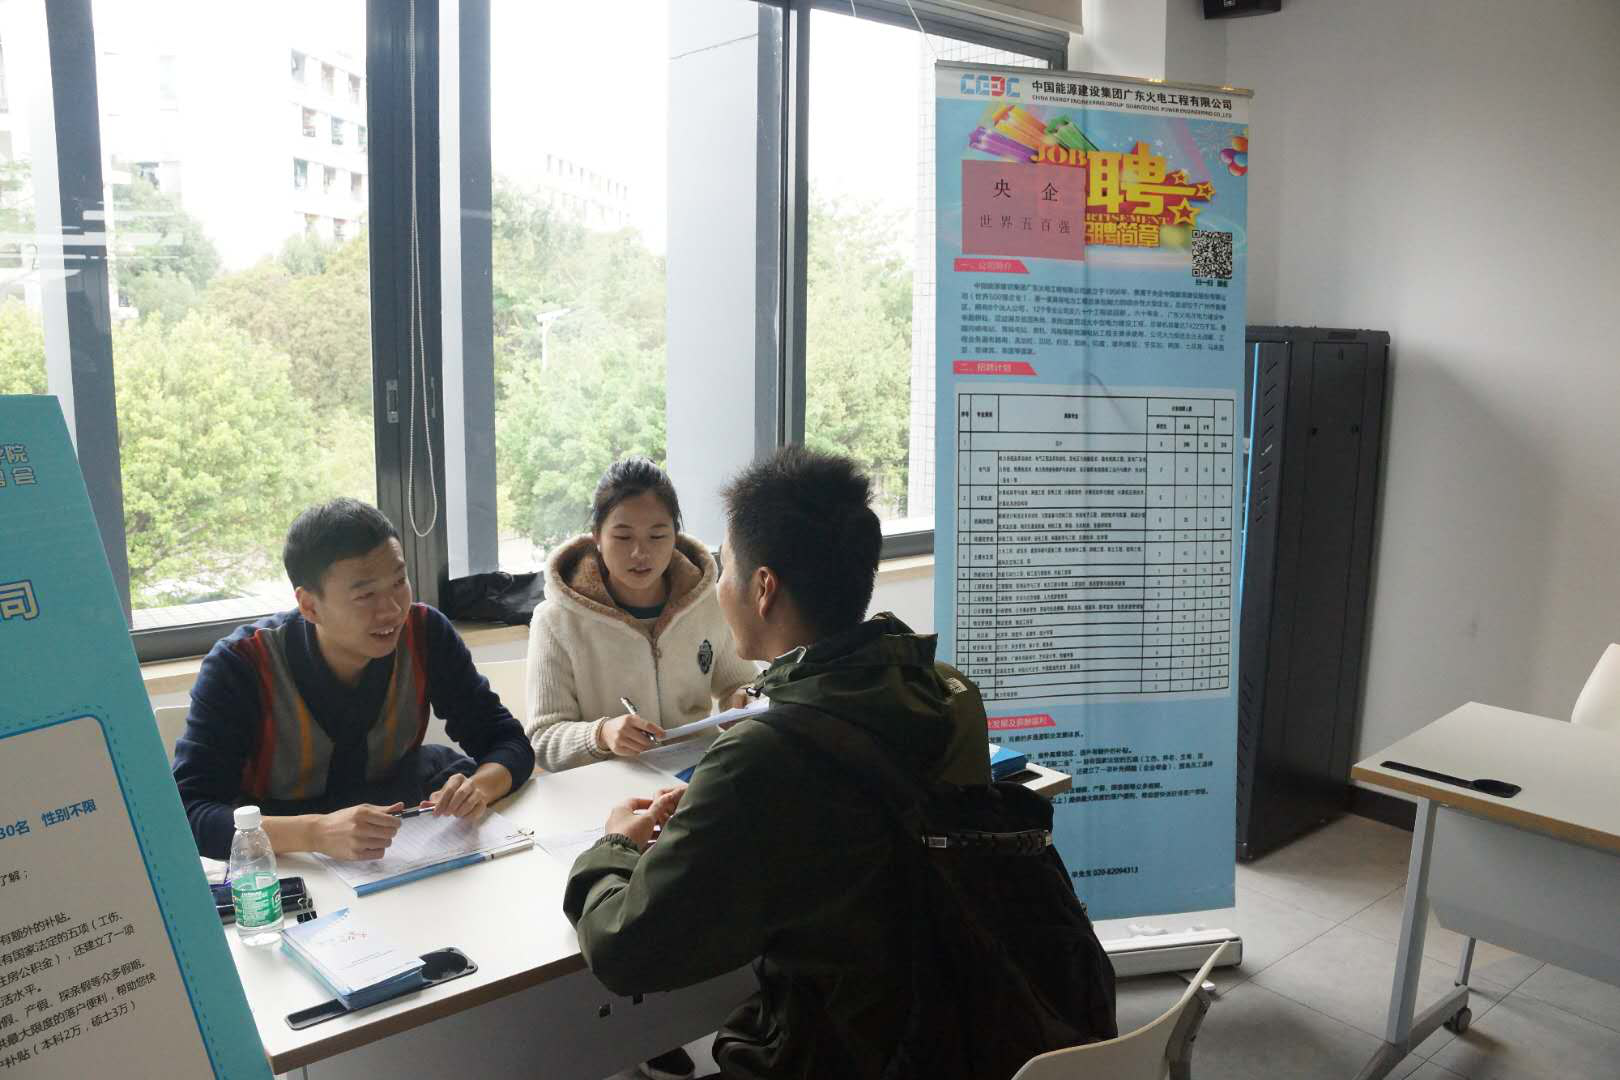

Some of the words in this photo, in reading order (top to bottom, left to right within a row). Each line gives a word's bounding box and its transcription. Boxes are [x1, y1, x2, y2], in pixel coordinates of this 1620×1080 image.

[1032, 80, 1232, 111] 中国能源建设集团广东火电工程有限公司
[1030, 144, 1087, 167] JOB
[1087, 141, 1196, 216] 聘
[0, 443, 29, 464] 院
[41, 798, 97, 827] 性别不限
